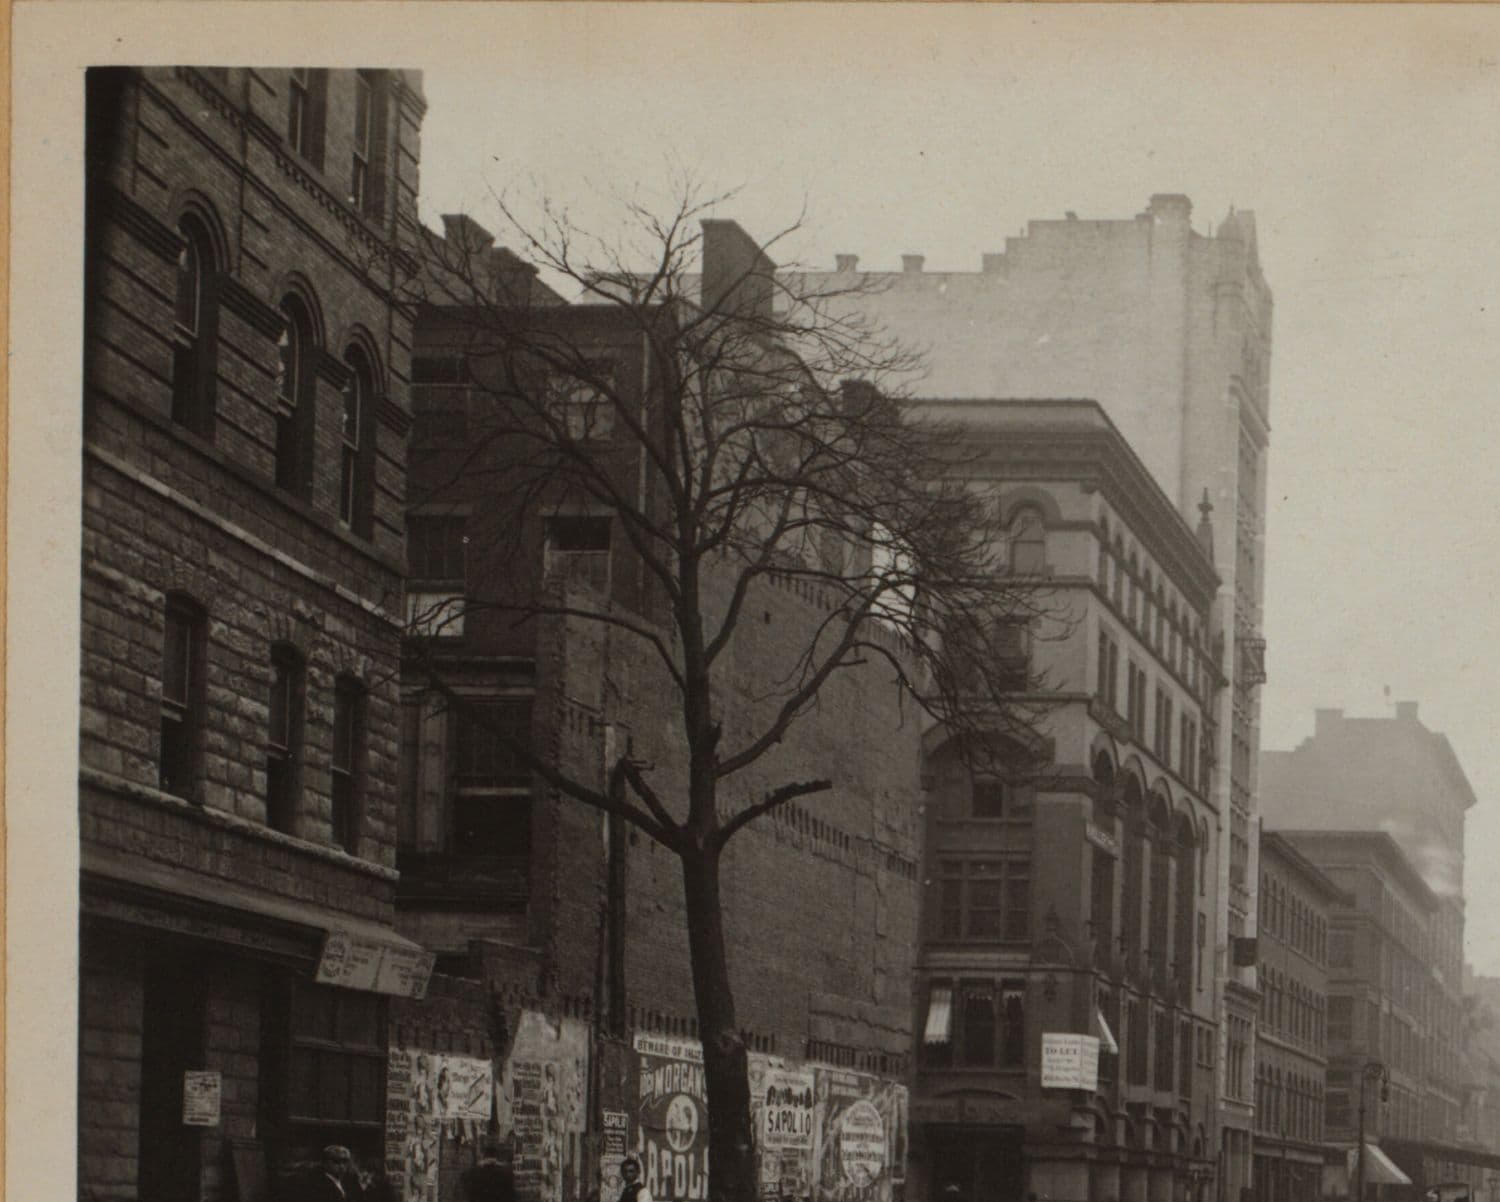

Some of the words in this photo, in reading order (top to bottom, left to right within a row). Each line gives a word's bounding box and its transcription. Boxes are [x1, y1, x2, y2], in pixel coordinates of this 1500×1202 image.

[637, 1039, 670, 1056] BEWARE
[671, 1045, 683, 1057] OF
[767, 1109, 811, 1137] SAPOLIO
